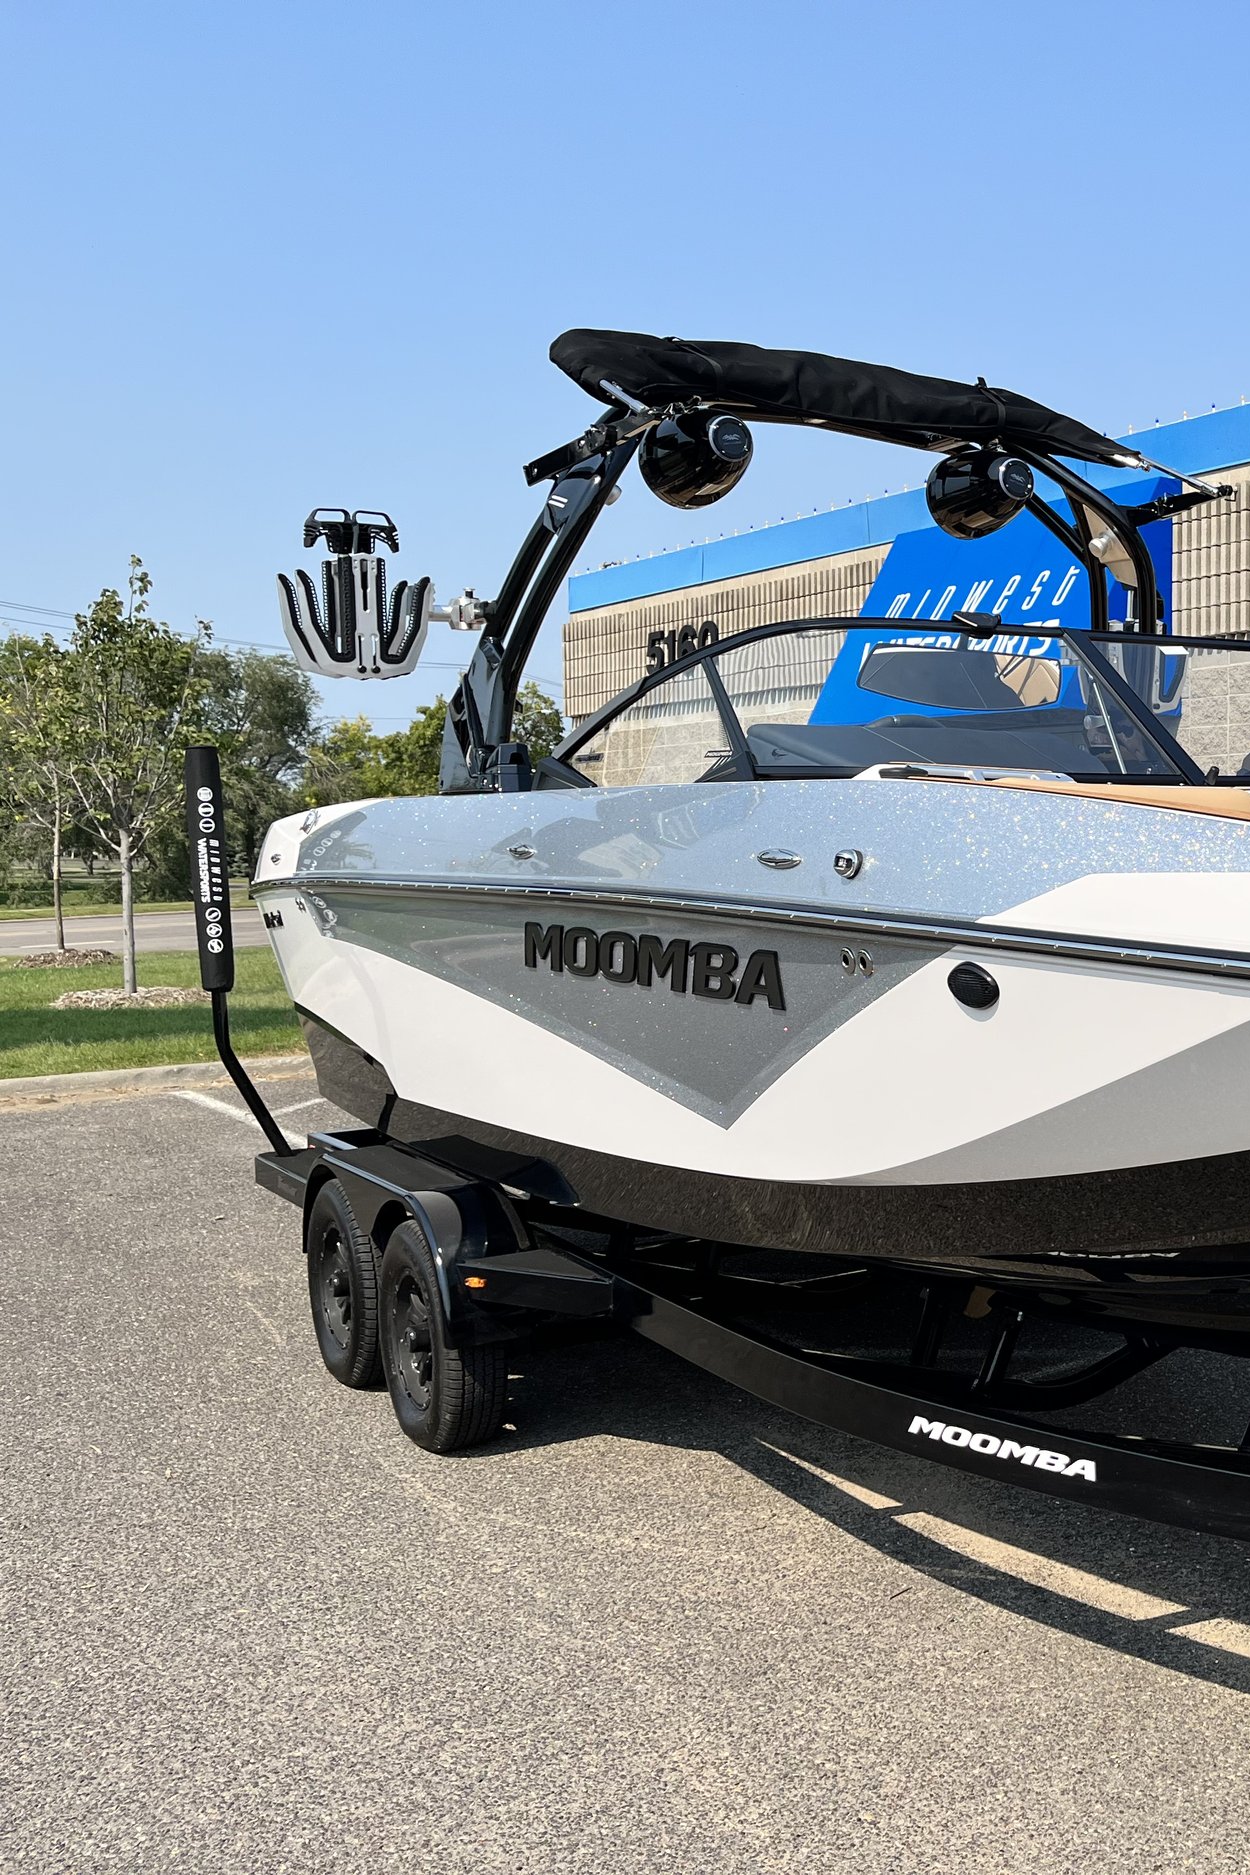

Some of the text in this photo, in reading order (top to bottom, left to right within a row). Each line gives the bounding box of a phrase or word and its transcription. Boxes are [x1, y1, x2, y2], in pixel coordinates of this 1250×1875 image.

[197, 837, 211, 903] WATERSPORTS
[524, 921, 786, 1011] MOOMBA
[907, 1415, 1097, 1482] MOOMBA
